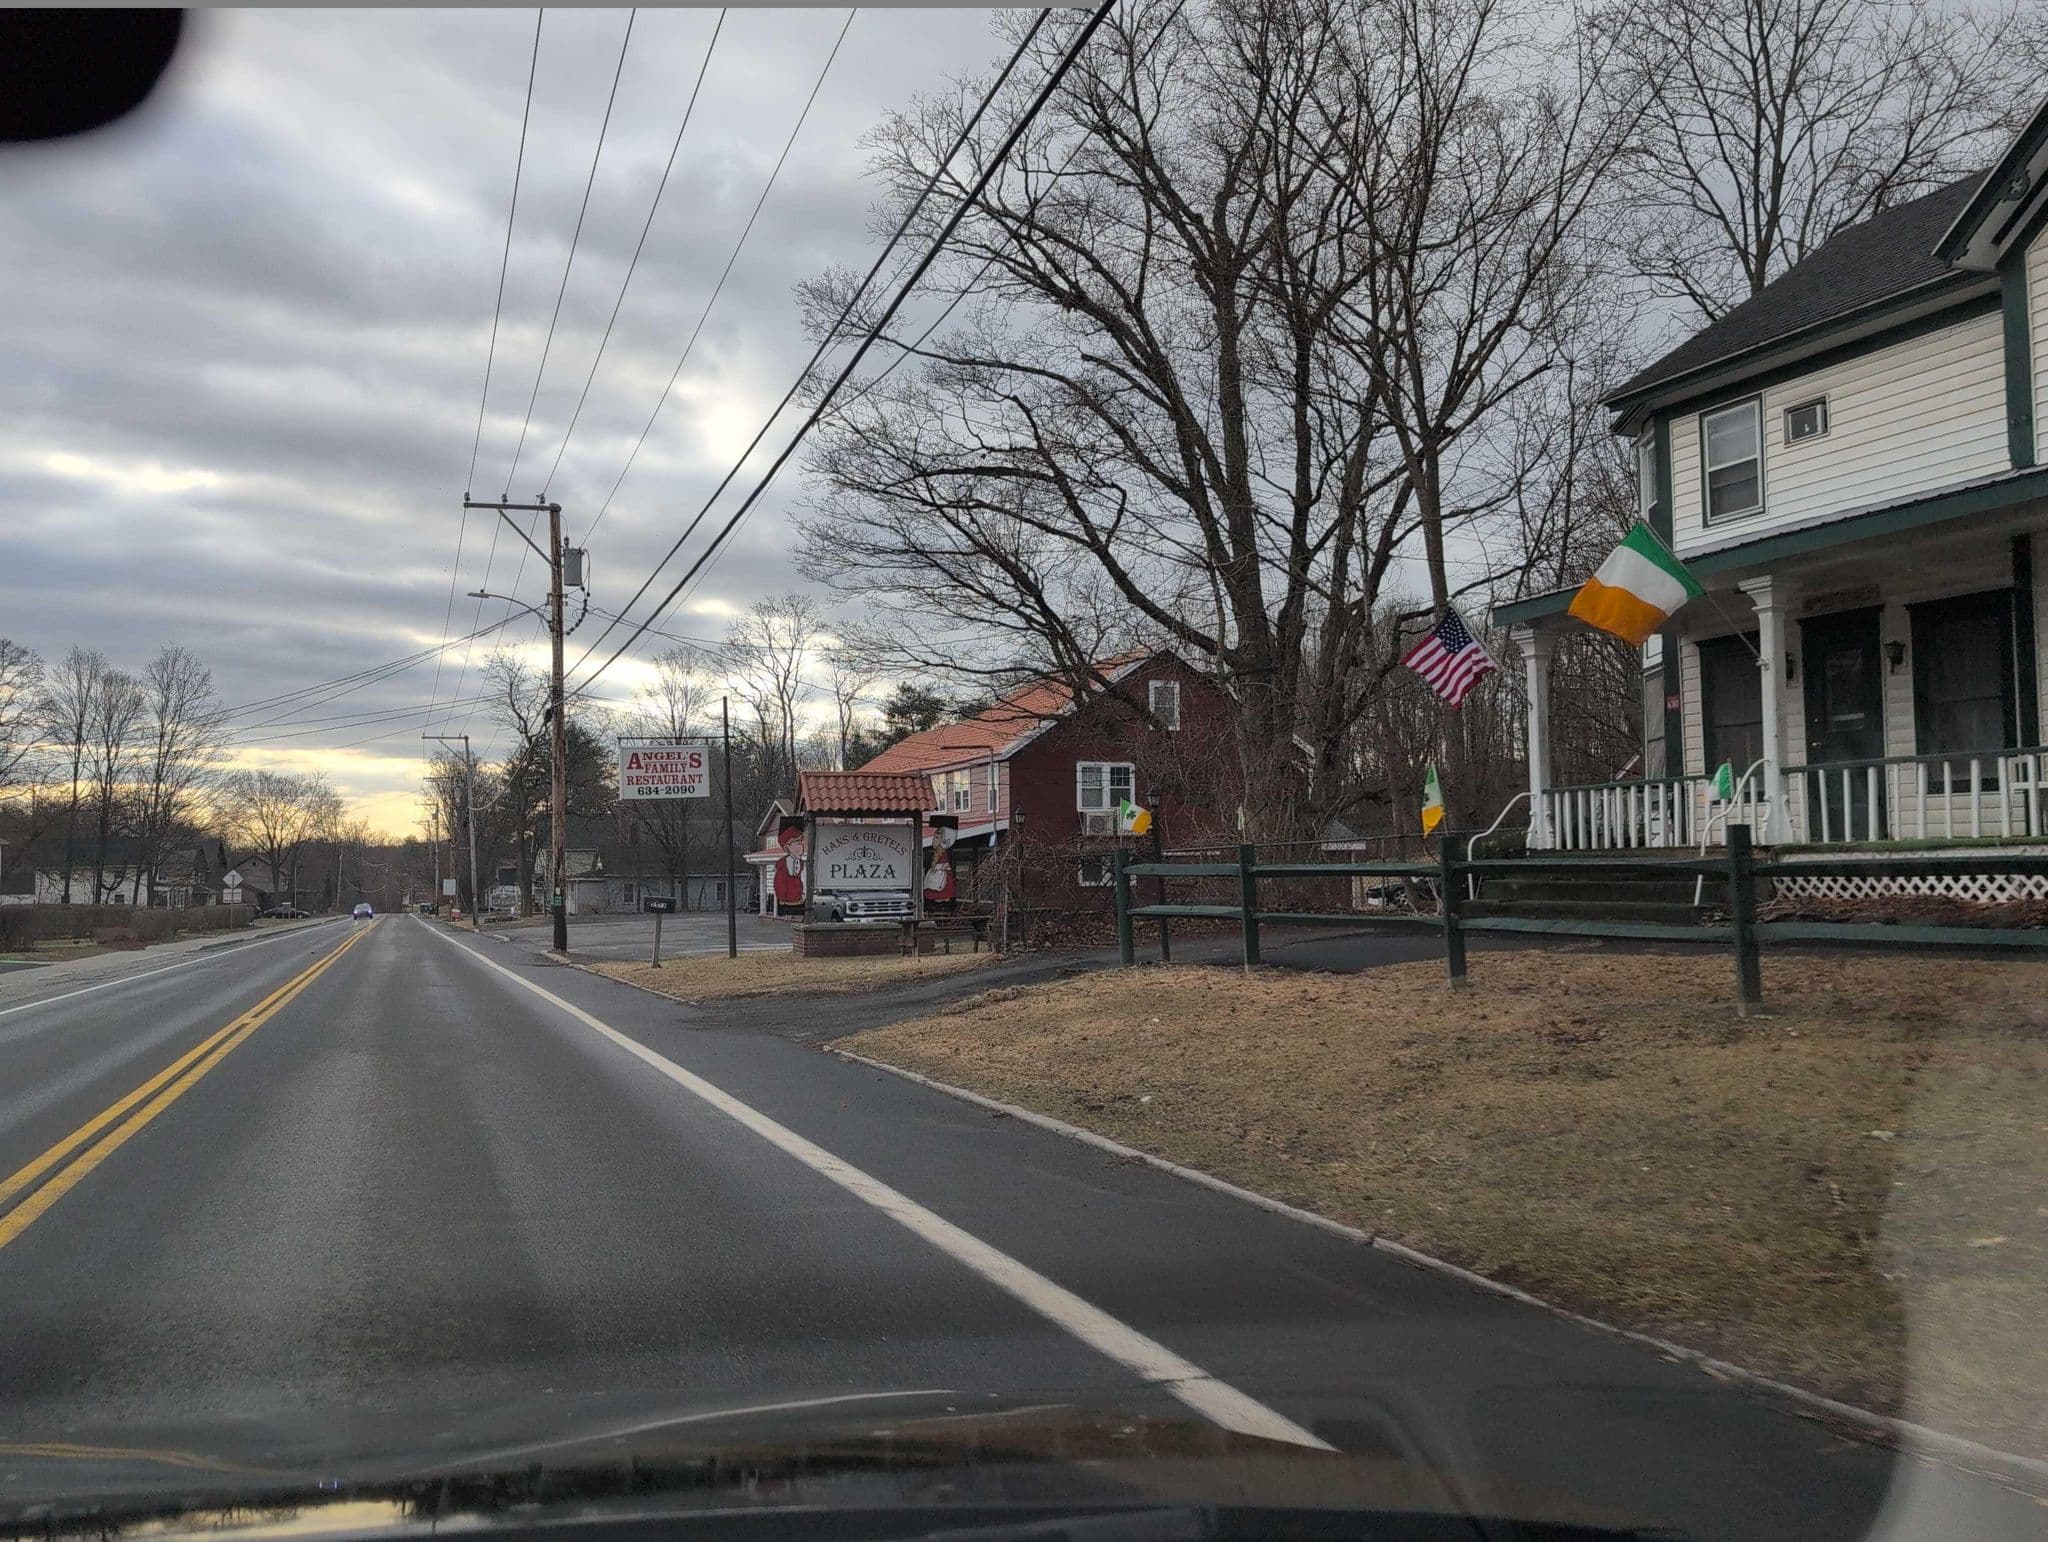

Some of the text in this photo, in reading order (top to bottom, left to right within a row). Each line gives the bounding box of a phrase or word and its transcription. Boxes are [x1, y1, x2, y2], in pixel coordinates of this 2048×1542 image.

[644, 763, 688, 773] FAMILY
[626, 774, 703, 785] RESTAURANT
[637, 785, 696, 796] 634-2090
[822, 834, 850, 855] HANS
[852, 833, 860, 842] &
[830, 864, 896, 878] PLAZA
